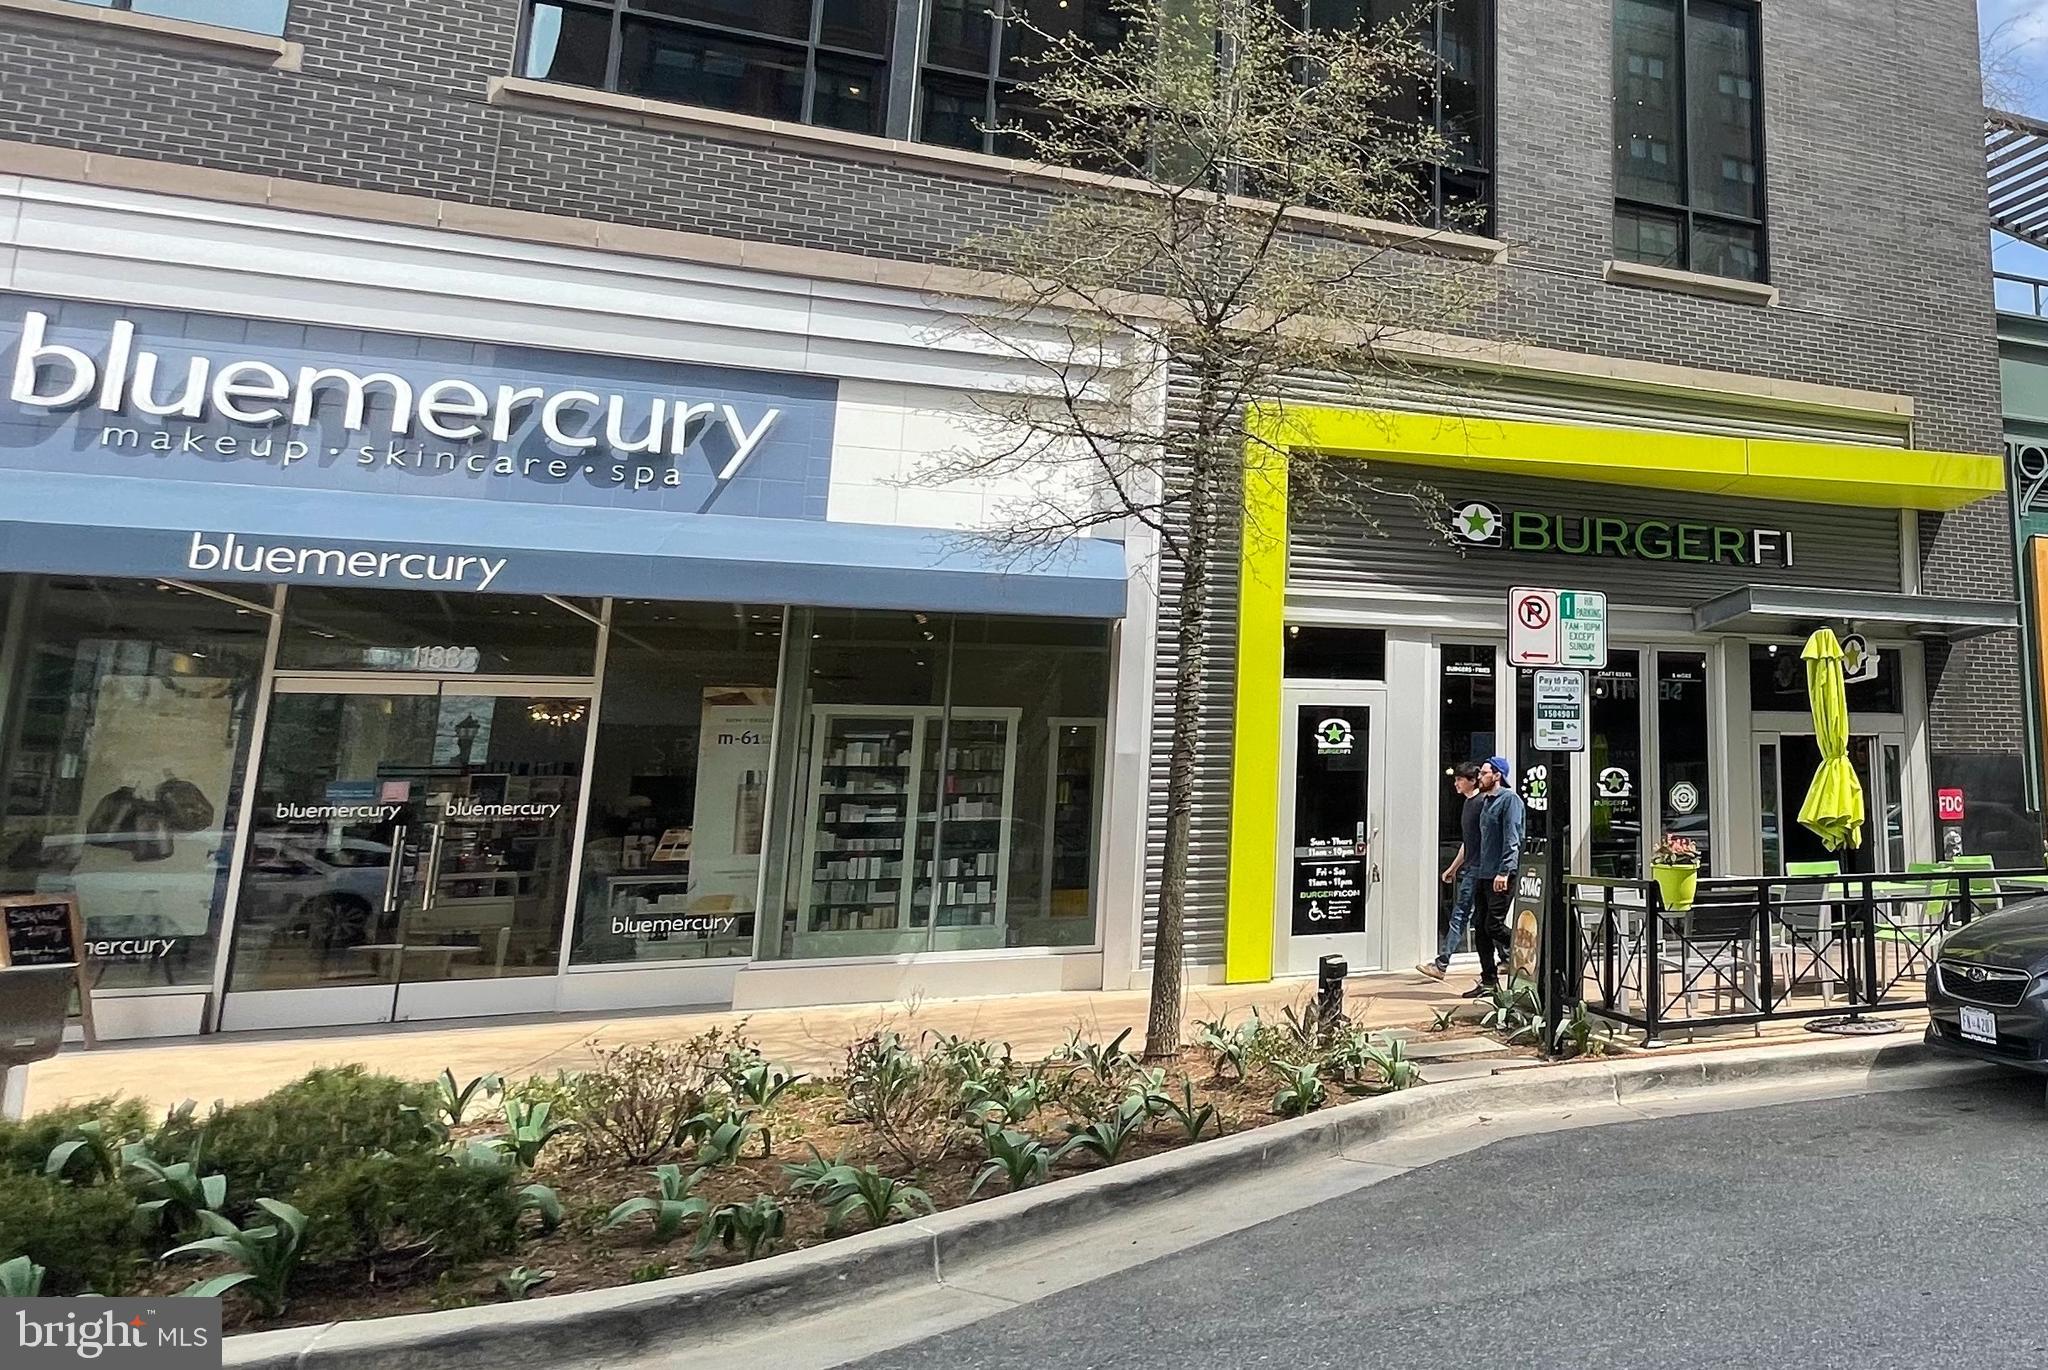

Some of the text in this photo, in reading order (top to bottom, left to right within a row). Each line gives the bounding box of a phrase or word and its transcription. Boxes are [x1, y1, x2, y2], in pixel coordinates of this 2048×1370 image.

[10, 310, 781, 480] bluemercury
[102, 425, 682, 490] makeup skincare spa
[1512, 511, 1793, 567] BURGERFI
[188, 531, 508, 593] bluemercury
[1565, 597, 1571, 615] 1
[1576, 608, 1602, 618] PARKING
[1569, 632, 1595, 641] EXCEPT
[1569, 642, 1595, 651] SUNDAY
[1539, 675, 1579, 686] Pay to Park
[718, 730, 760, 745] m-61
[1526, 764, 1547, 781] TO
[276, 802, 402, 821] bluemercury
[445, 800, 561, 818] bluemercury
[1938, 795, 1963, 813] FDC
[1309, 837, 1353, 846] Sun Thurs
[1308, 848, 1328, 856] 11am
[1316, 867, 1346, 876] Fri Sat
[1308, 877, 1353, 887] 11am 11pm
[1519, 875, 1542, 898] SWAG
[611, 916, 736, 934] bluemercury
